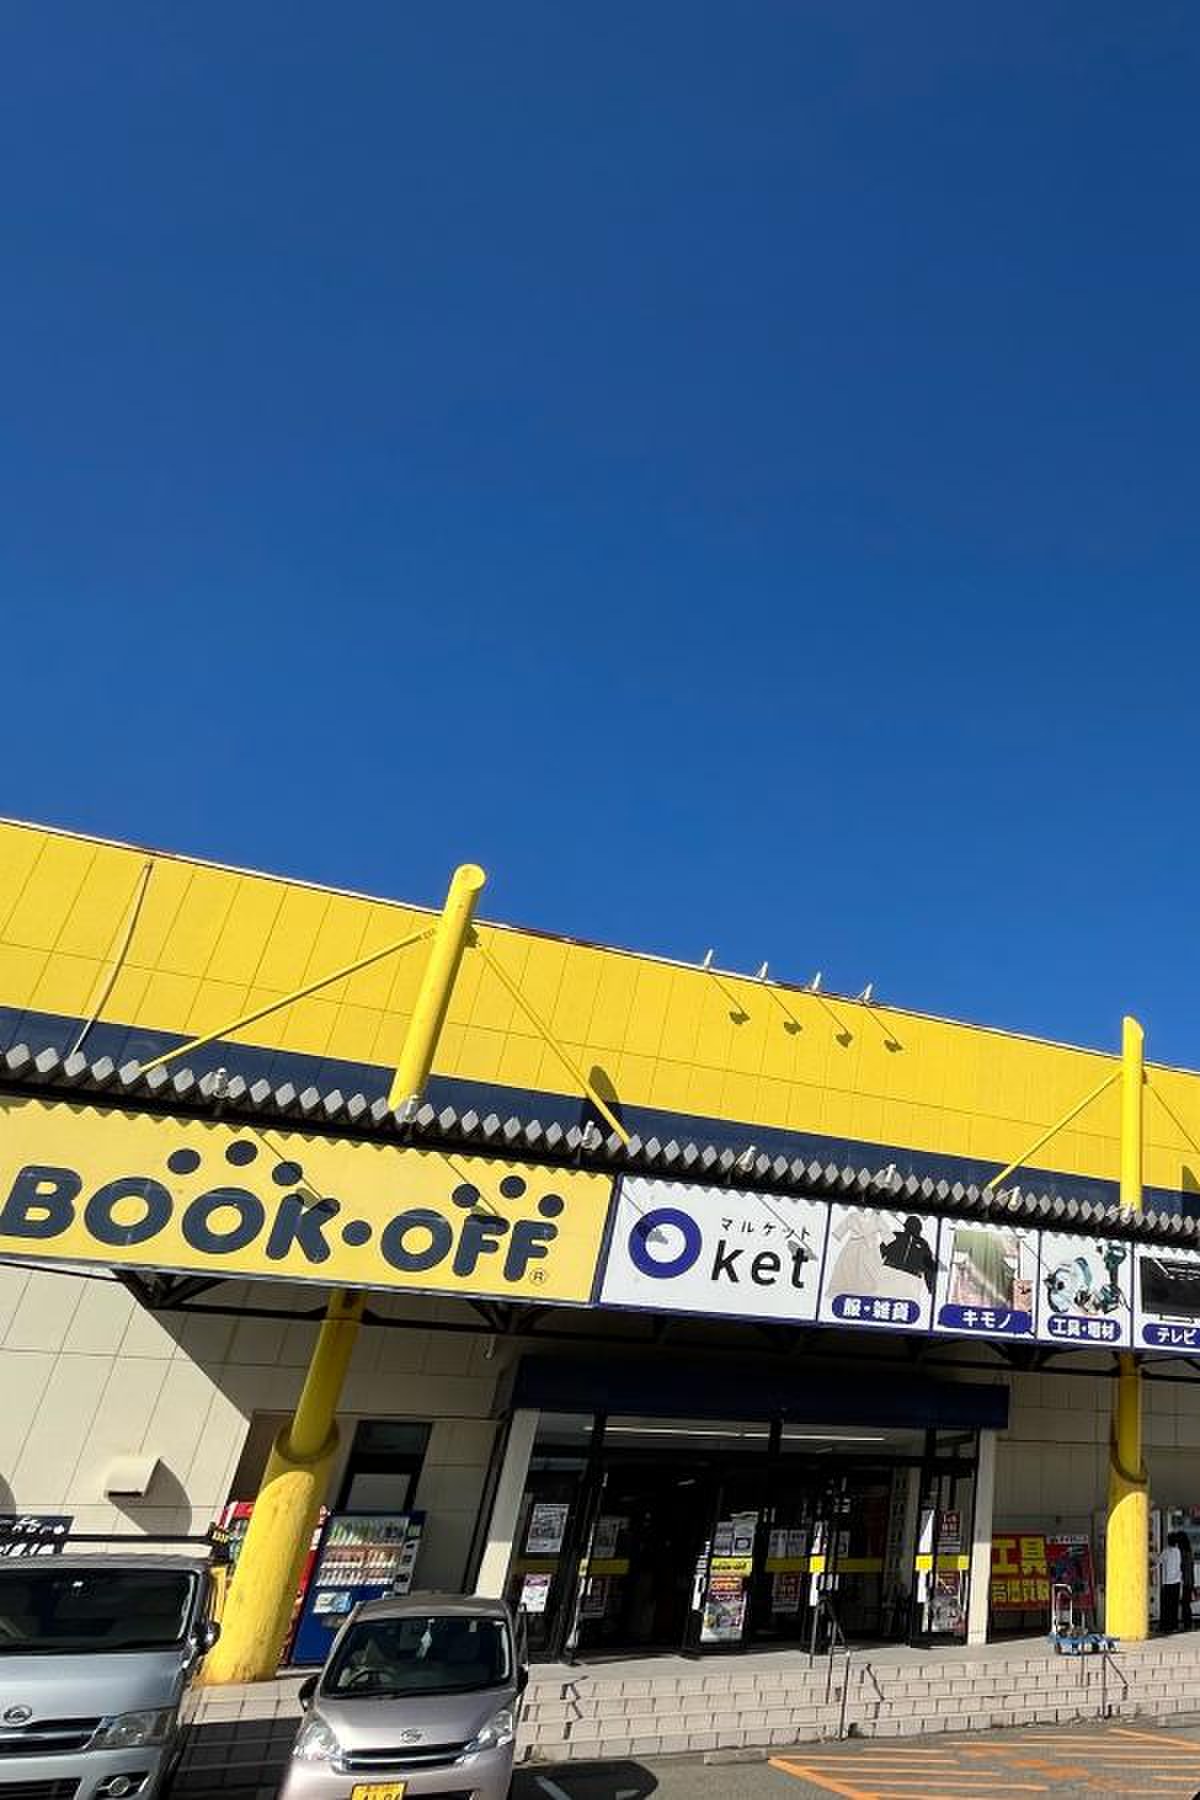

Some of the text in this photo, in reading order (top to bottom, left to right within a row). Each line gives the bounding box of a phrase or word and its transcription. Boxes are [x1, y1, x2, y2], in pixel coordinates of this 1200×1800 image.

[720, 1216, 813, 1240] マルケット
[843, 1297, 911, 1322] 服・雑貨
[962, 1309, 1012, 1328] キモノ
[1157, 1328, 1197, 1345] テレビ
[991, 1537, 1047, 1576] 工具
